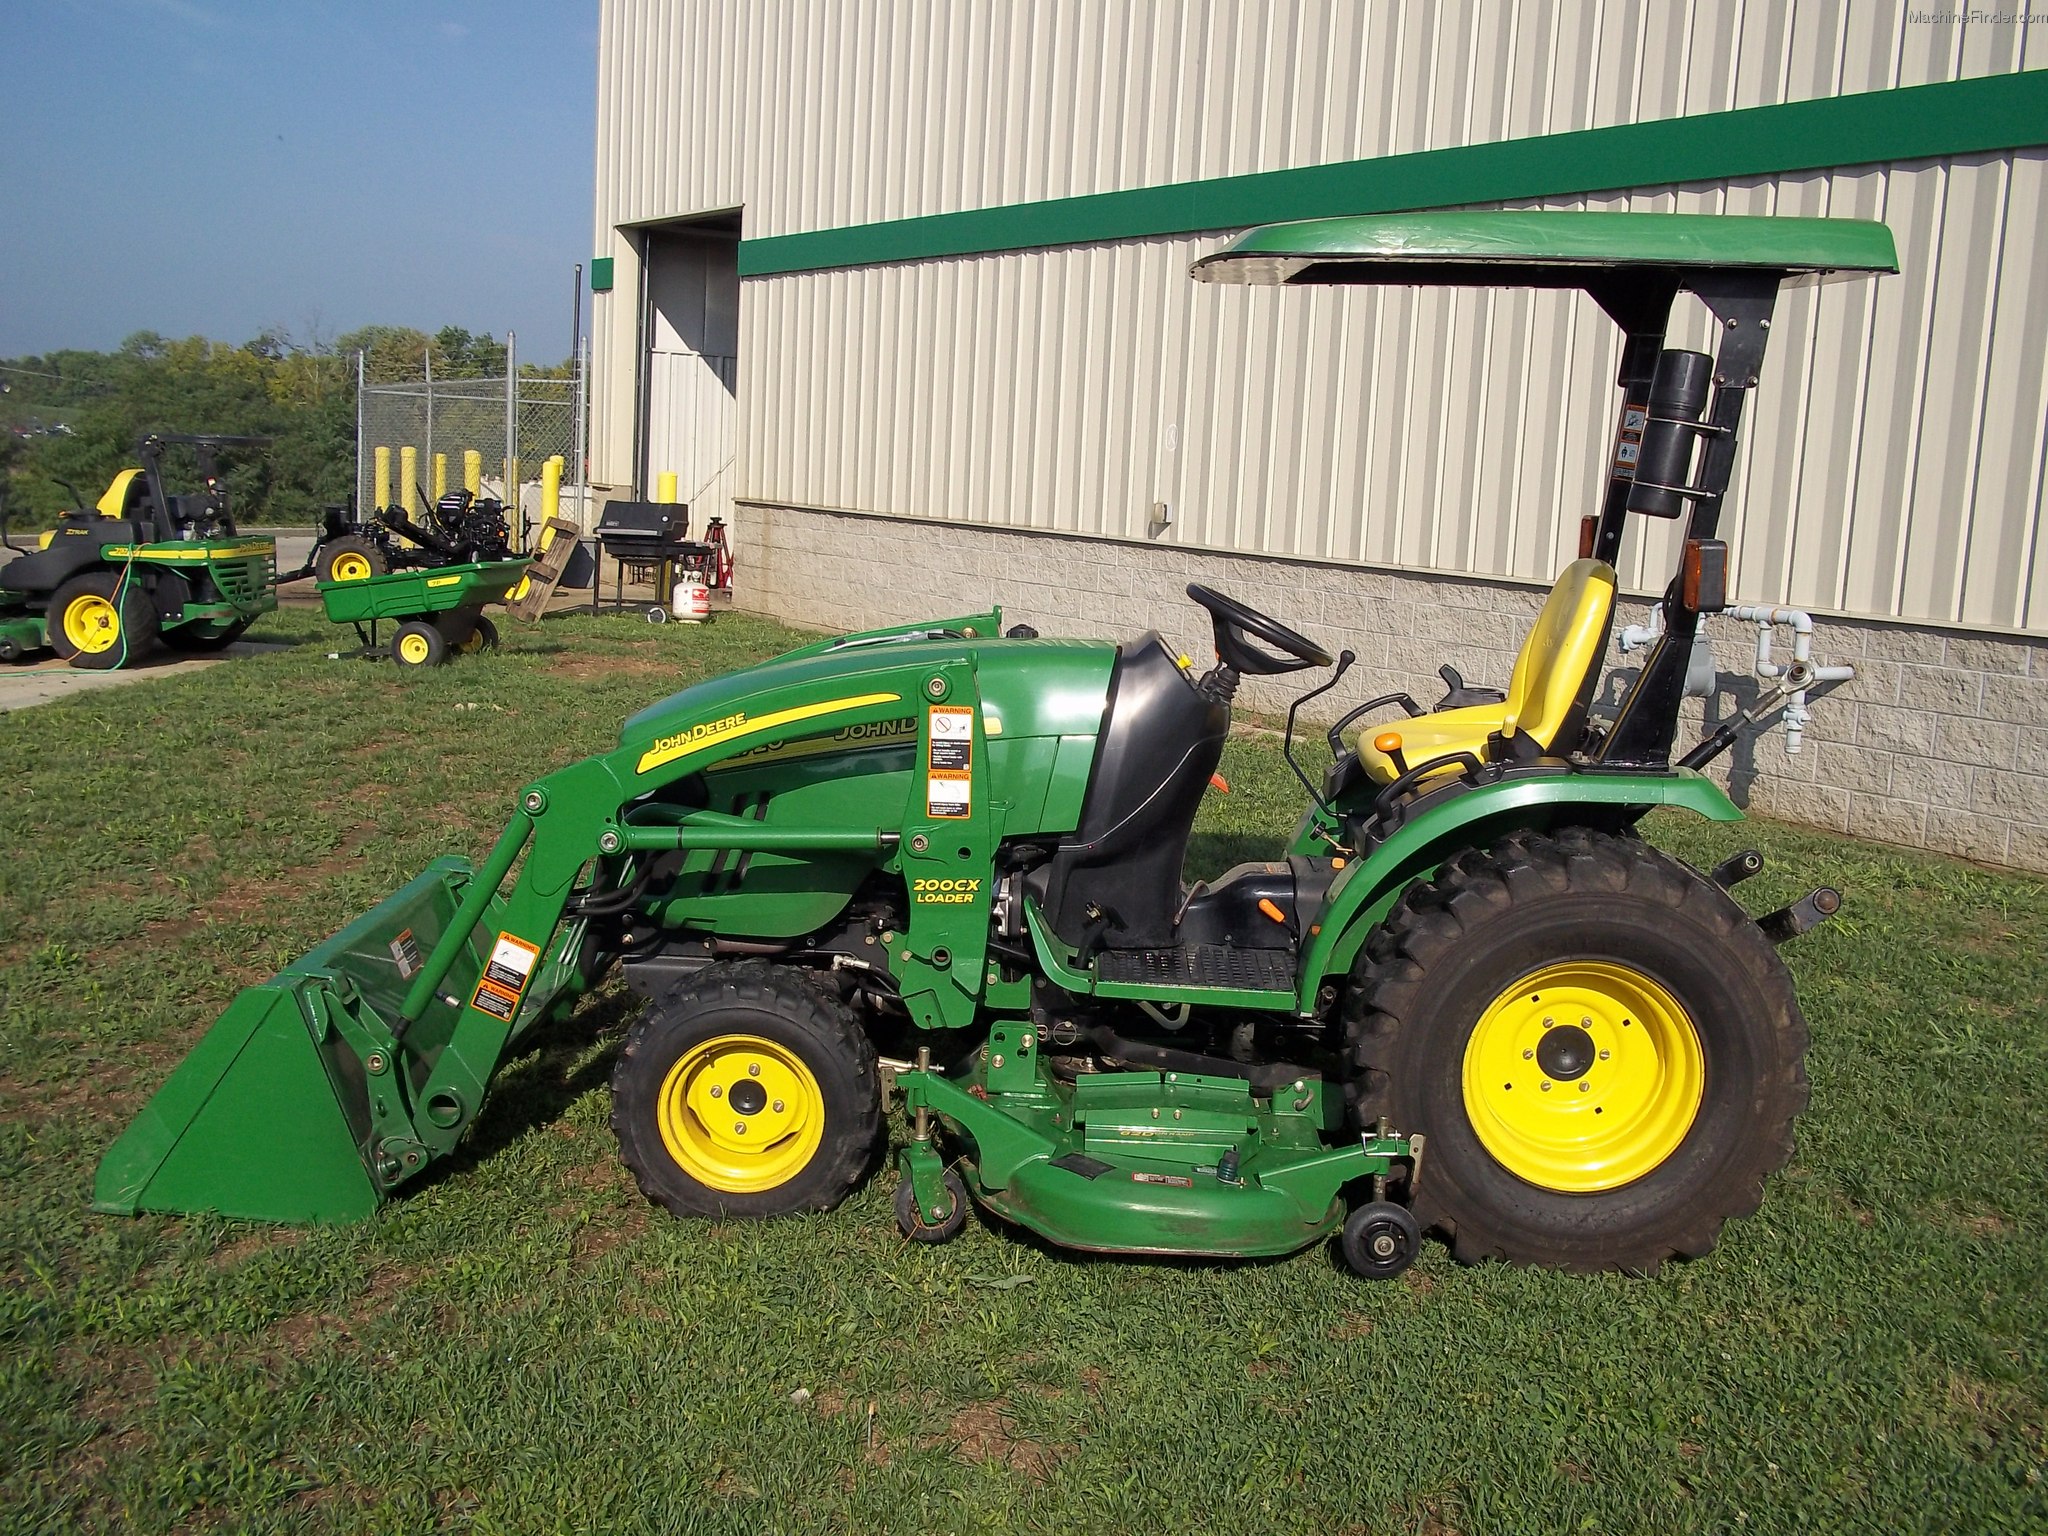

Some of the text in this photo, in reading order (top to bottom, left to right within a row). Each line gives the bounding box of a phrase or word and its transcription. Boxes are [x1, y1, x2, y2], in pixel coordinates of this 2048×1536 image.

[650, 712, 747, 755] JOHN DEERE
[834, 720, 899, 741] JOHN
[913, 878, 981, 892] 200CX
[916, 893, 974, 903] LOADER
[511, 938, 535, 952] WARNING
[490, 987, 515, 1000] WARNING
